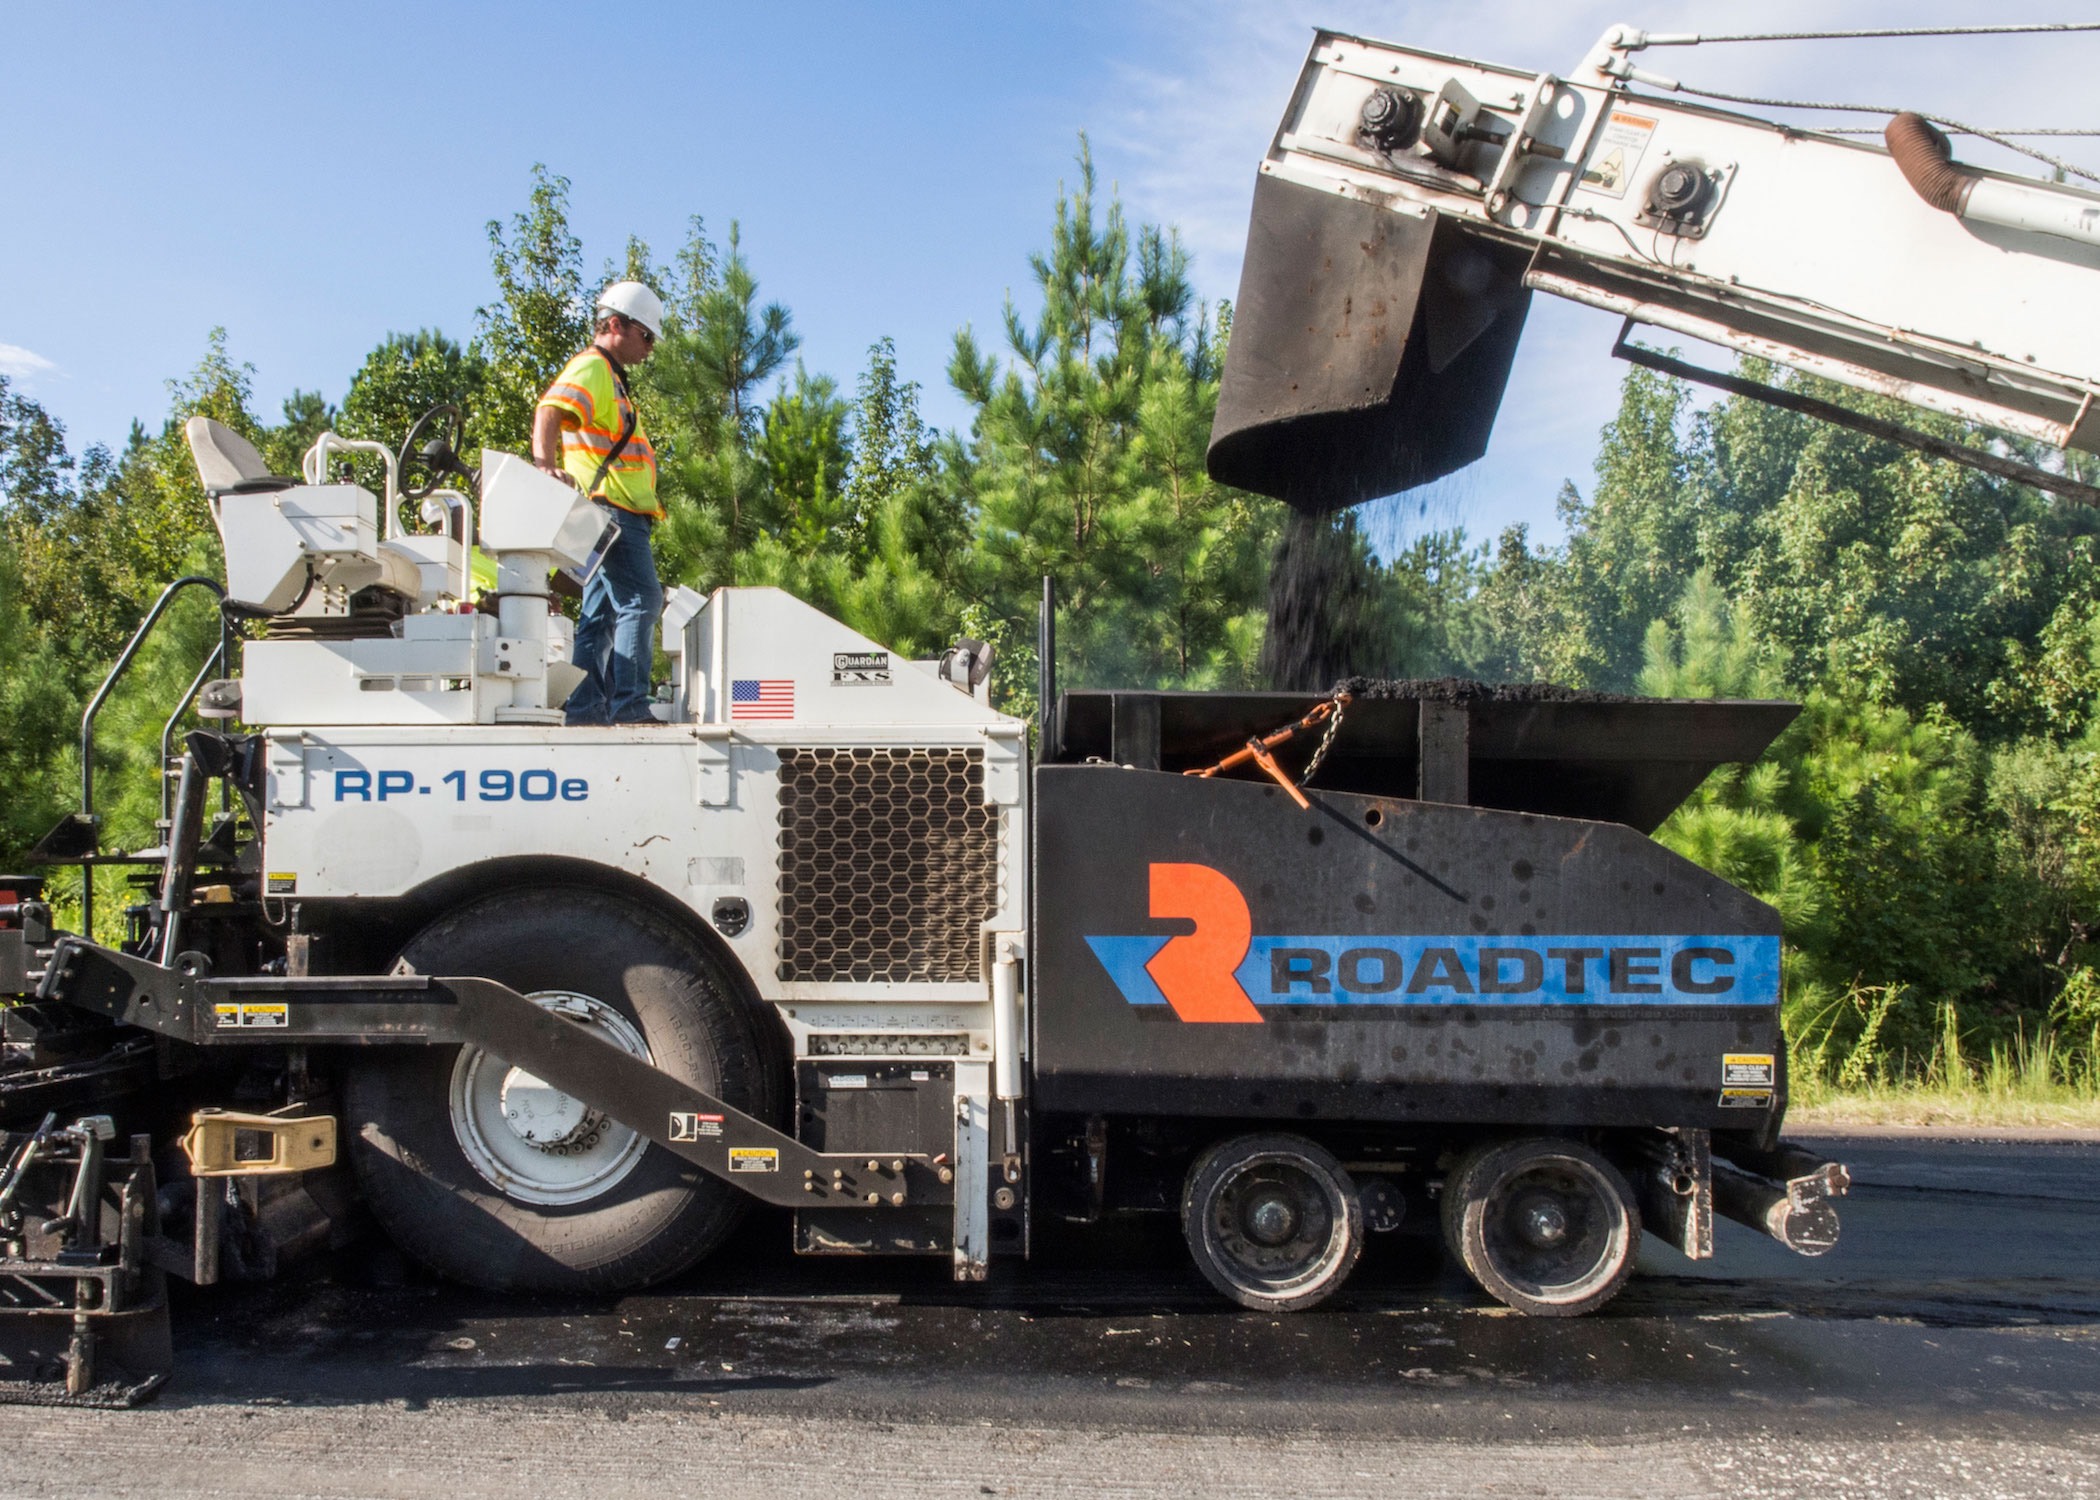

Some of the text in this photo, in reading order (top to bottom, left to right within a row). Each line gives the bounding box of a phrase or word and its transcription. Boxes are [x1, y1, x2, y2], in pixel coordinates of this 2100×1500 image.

[835, 655, 887, 669] GUARDIAN
[335, 769, 589, 801] RP-190e
[1270, 948, 1735, 994] ROADTEC
[1541, 1008, 1581, 1019] Aste
